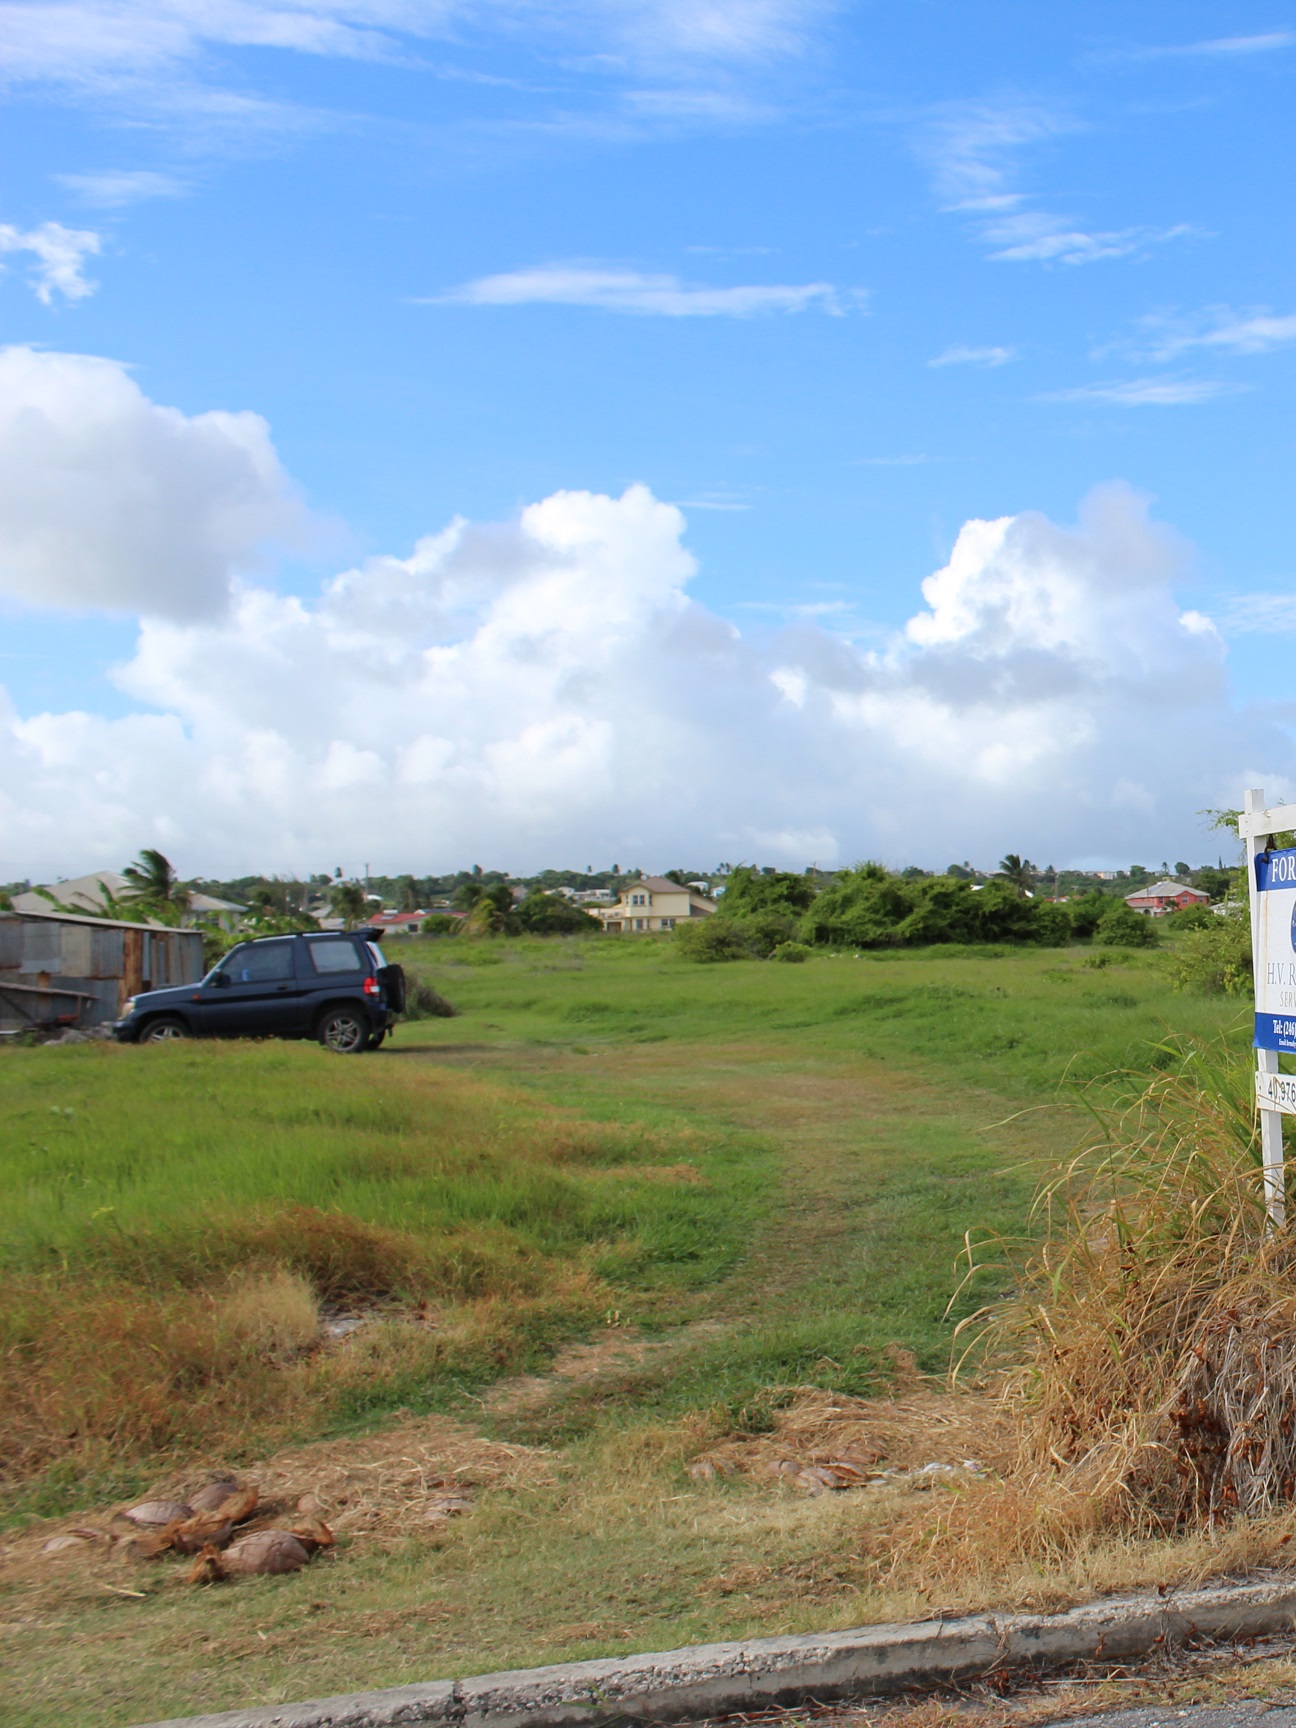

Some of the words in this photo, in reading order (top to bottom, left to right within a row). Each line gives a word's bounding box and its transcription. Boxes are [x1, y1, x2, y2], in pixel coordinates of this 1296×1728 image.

[1271, 856, 1296, 882] FOR
[1267, 962, 1286, 985] H.V.
[1272, 1019, 1283, 1034] Tel:
[1283, 1021, 1296, 1039] (246)
